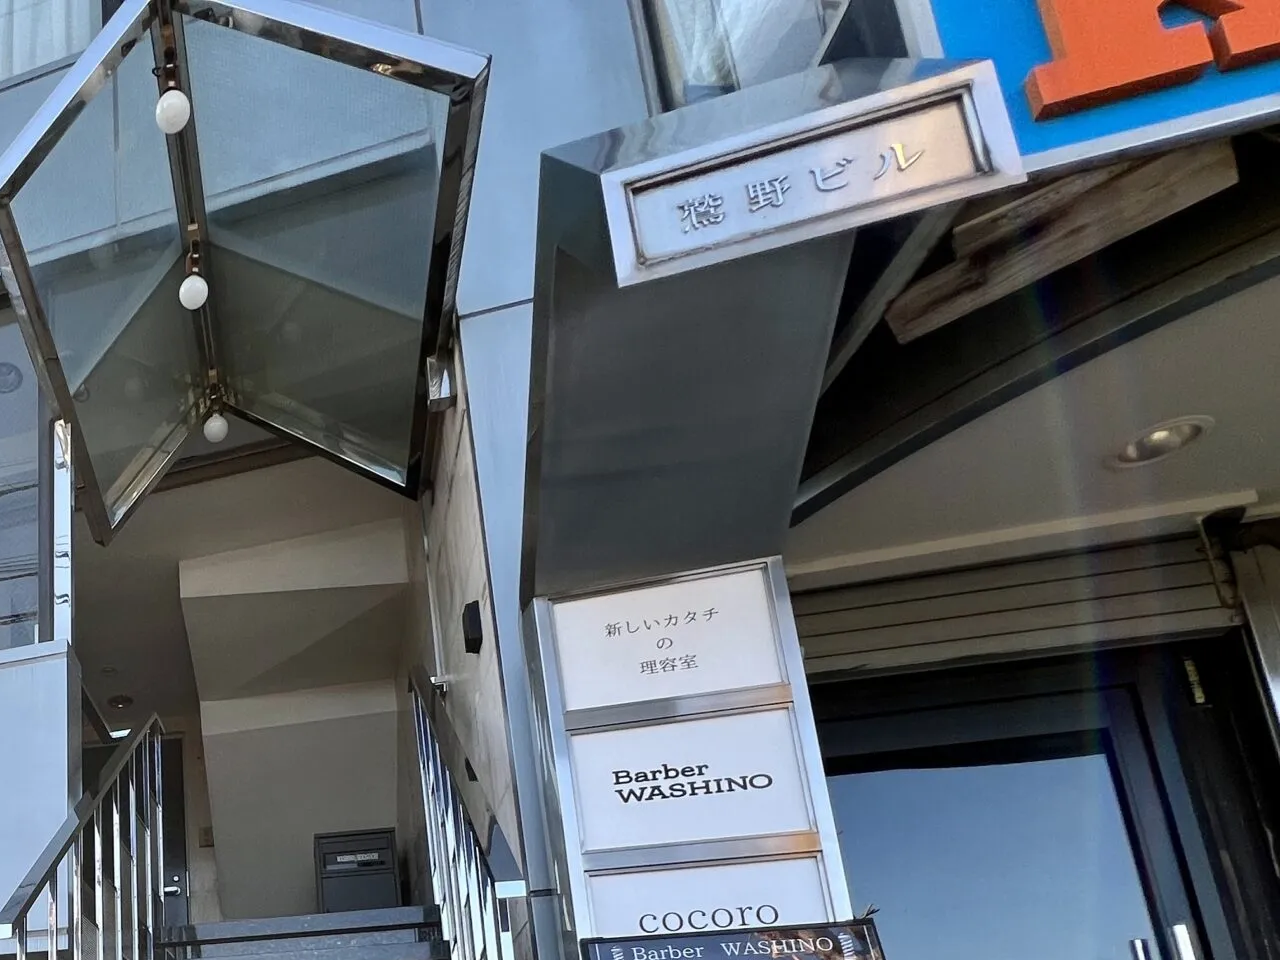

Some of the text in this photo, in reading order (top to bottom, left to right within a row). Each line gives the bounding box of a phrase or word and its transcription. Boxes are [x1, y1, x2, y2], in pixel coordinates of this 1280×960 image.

[678, 143, 925, 233] 鷲野ビル
[605, 607, 720, 638] 新しいカタチ
[657, 637, 673, 650] の
[639, 654, 699, 675] 理容室
[612, 763, 710, 786] Barber
[615, 774, 774, 804] WASHINO
[638, 904, 779, 934] cocoro
[720, 937, 834, 958] WASHINO
